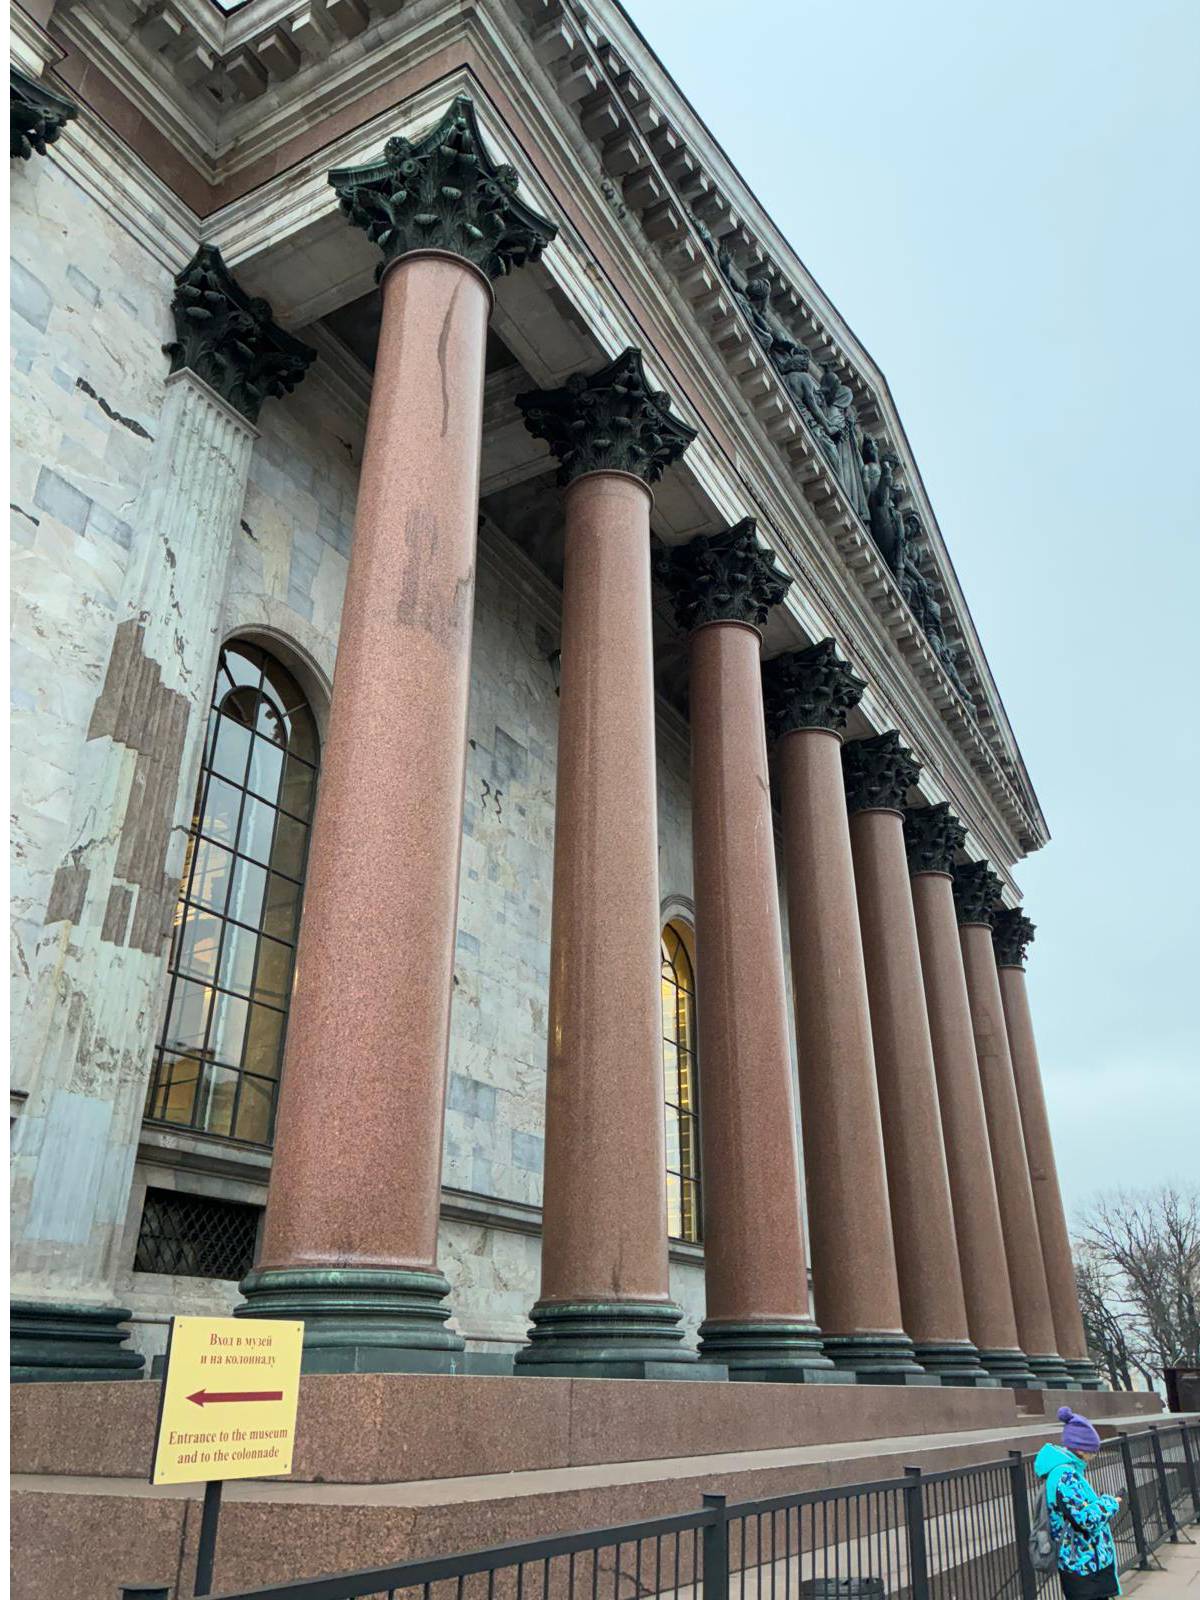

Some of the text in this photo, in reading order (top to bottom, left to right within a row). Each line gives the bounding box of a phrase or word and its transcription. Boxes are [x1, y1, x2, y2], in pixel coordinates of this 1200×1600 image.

[210, 1333, 273, 1350] Вход в музей
[200, 1356, 276, 1367] и на колоннаду
[169, 1428, 288, 1445] Entrance to the museum
[177, 1446, 280, 1464] and to the colonnade
